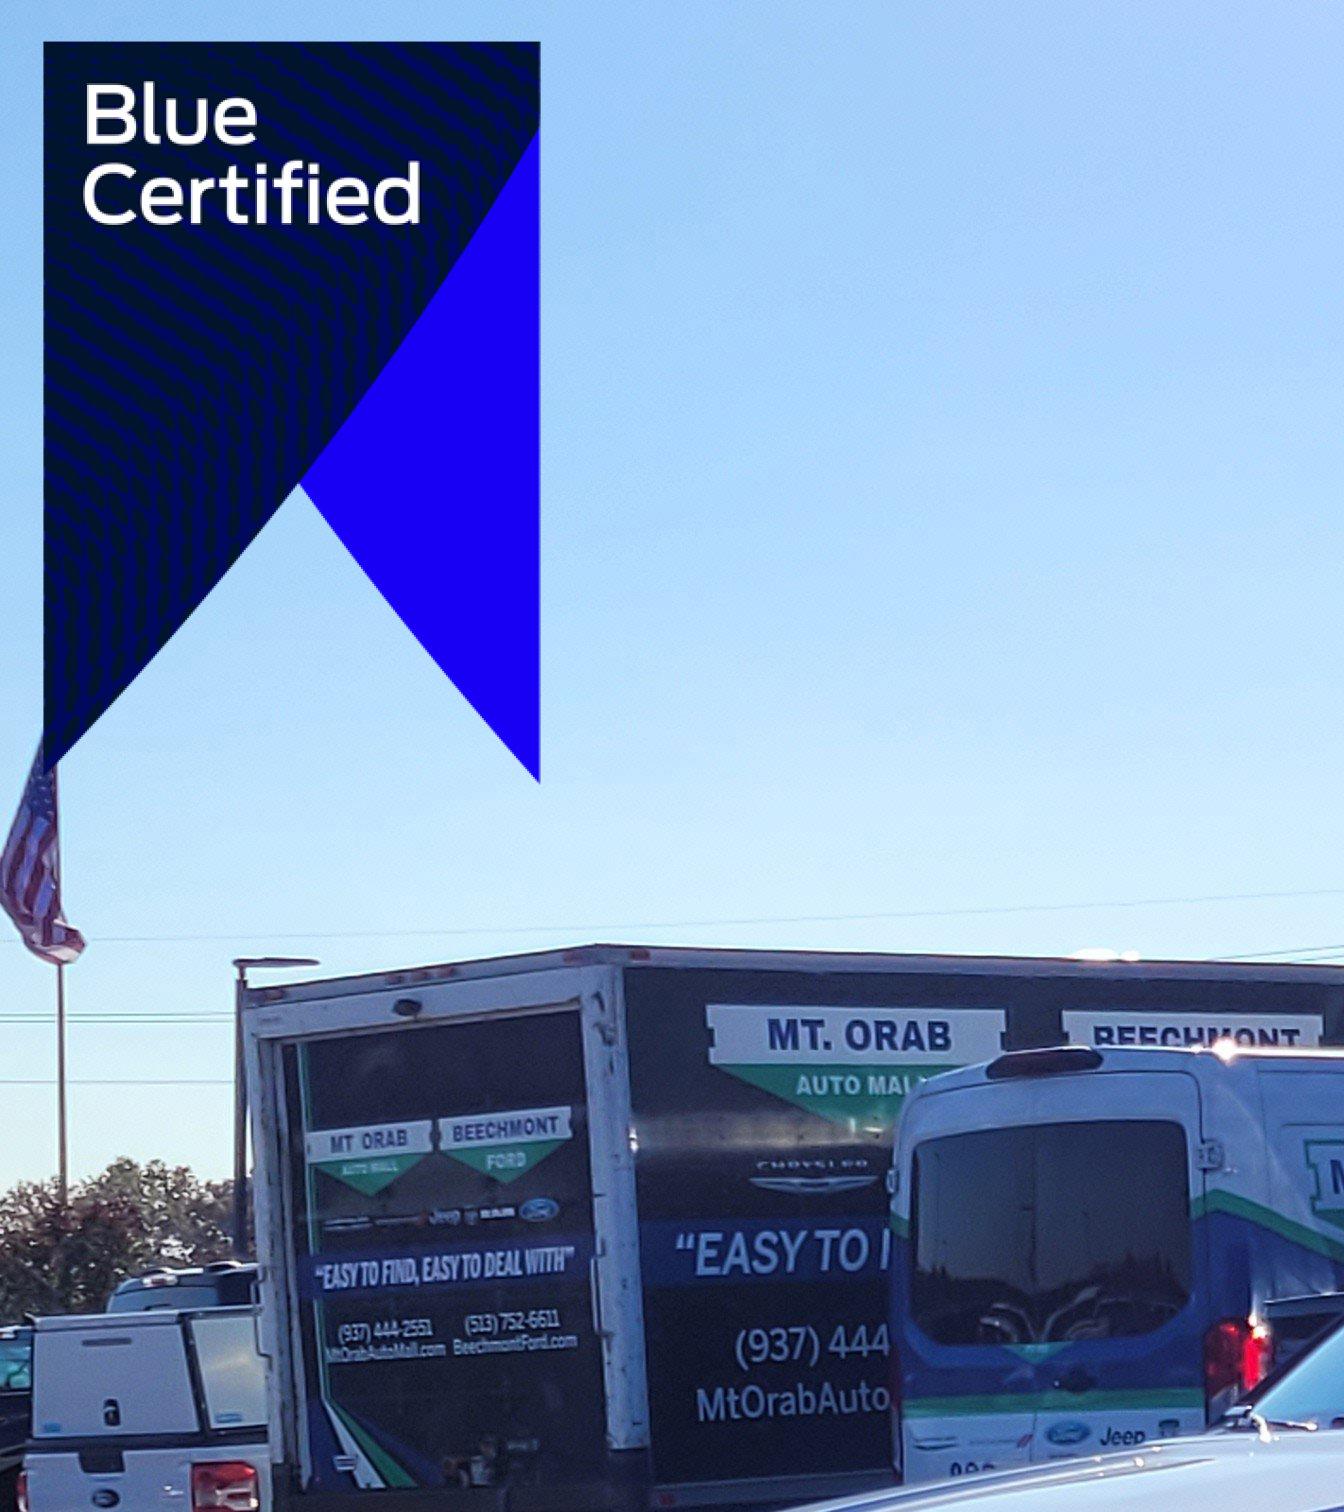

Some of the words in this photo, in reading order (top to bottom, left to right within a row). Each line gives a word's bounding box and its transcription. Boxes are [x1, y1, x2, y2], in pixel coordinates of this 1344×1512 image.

[767, 1018, 832, 1051] MT.
[844, 1019, 952, 1051] ORAB
[1093, 1024, 1301, 1047] BEECHMONT
[796, 1075, 861, 1096] AUTO
[867, 1075, 911, 1096] MAL
[330, 1134, 354, 1153] MT
[362, 1129, 408, 1150] ORAB
[453, 1116, 560, 1143] BEECHMONT
[486, 1152, 527, 1170] FORD
[813, 1227, 870, 1272] TO
[360, 1260, 379, 1287] TO
[382, 1257, 420, 1287] FIND,
[422, 1253, 461, 1283] EASY
[462, 1252, 481, 1279] TO
[484, 1250, 522, 1278] DEAL
[337, 1322, 372, 1345] (937)
[464, 1313, 499, 1337] (513)
[735, 1324, 820, 1371] (937)
[1100, 1427, 1146, 1446] Jeep
